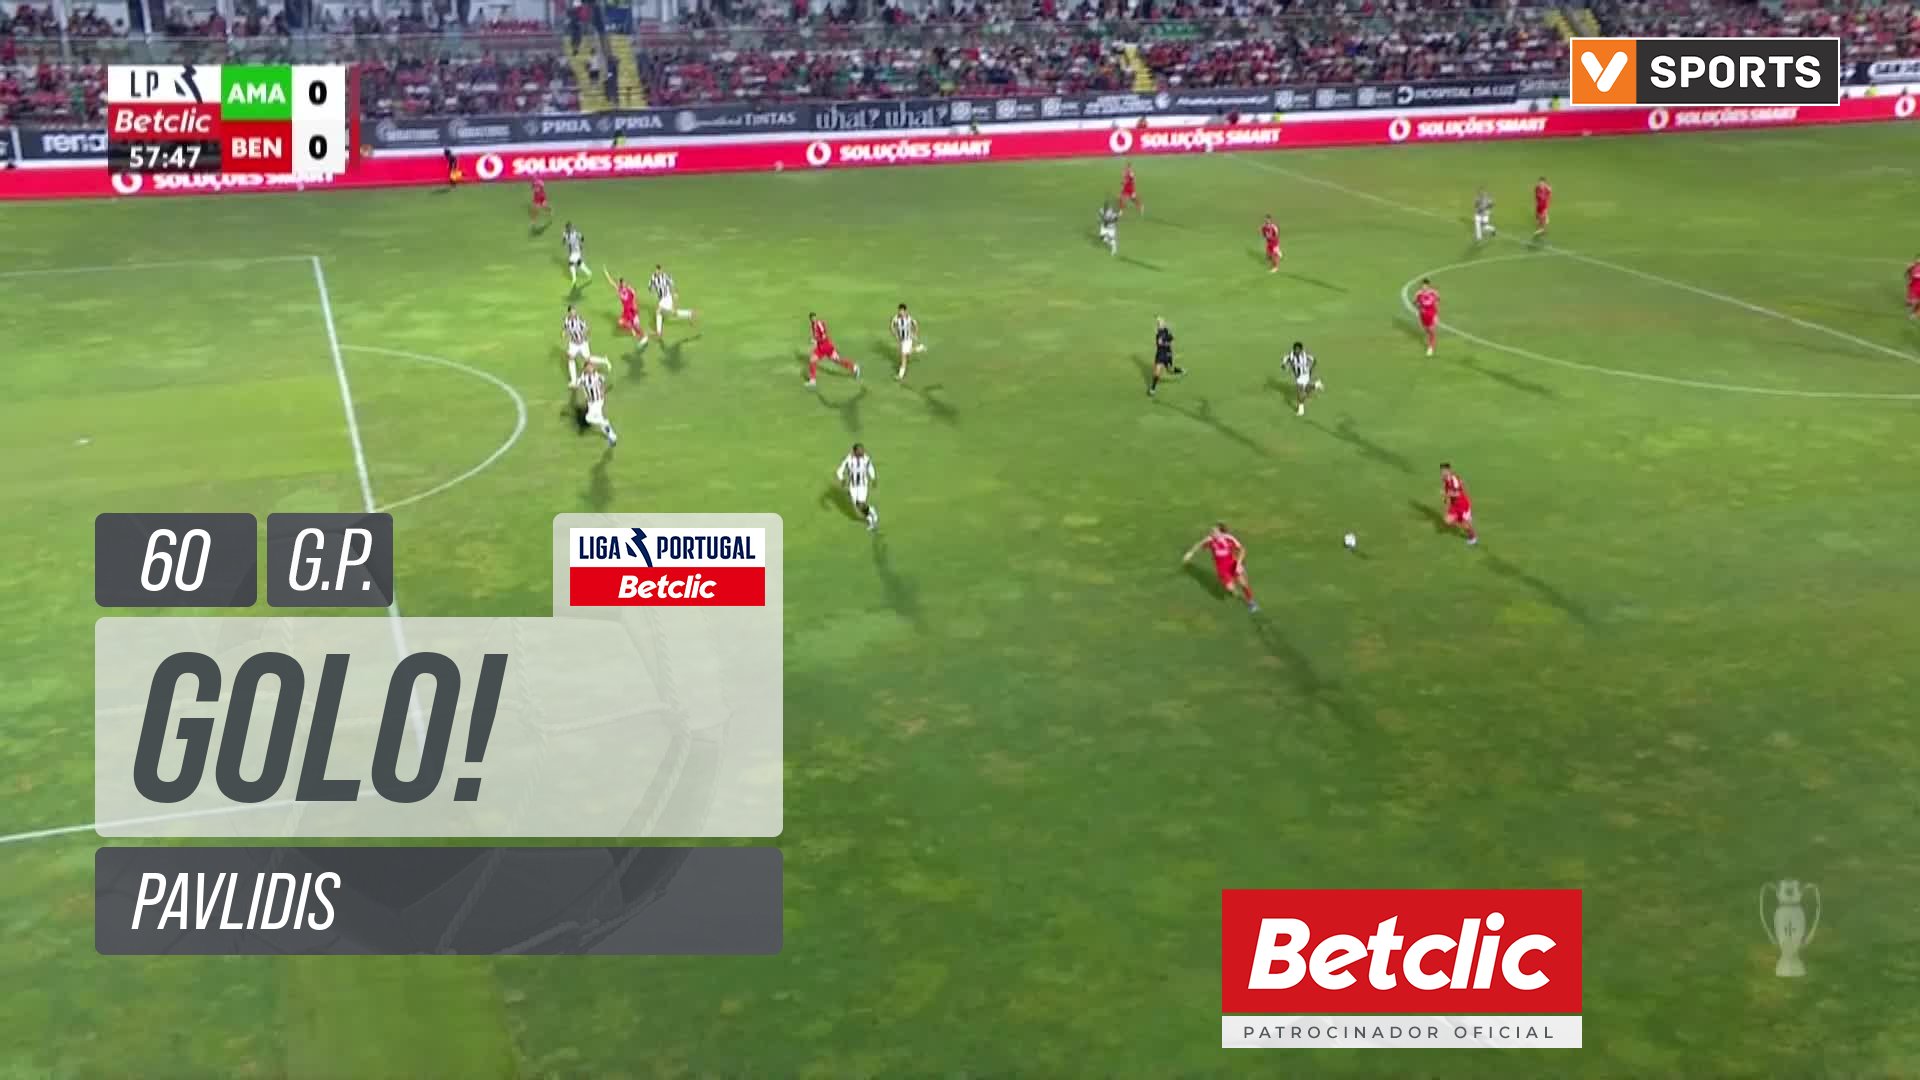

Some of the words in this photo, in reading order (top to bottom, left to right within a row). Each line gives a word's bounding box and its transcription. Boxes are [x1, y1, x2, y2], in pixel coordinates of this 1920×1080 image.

[1417, 116, 1493, 138] SOLUÇÕES
[1494, 115, 1549, 133] SMART
[1141, 128, 1225, 150] SOLUÇÕES
[1225, 127, 1281, 145] SMART
[840, 140, 932, 163] SOLUÇÕES
[932, 139, 992, 158] SMART
[512, 152, 612, 176] SOLUÇÕES
[612, 151, 679, 170] SMART
